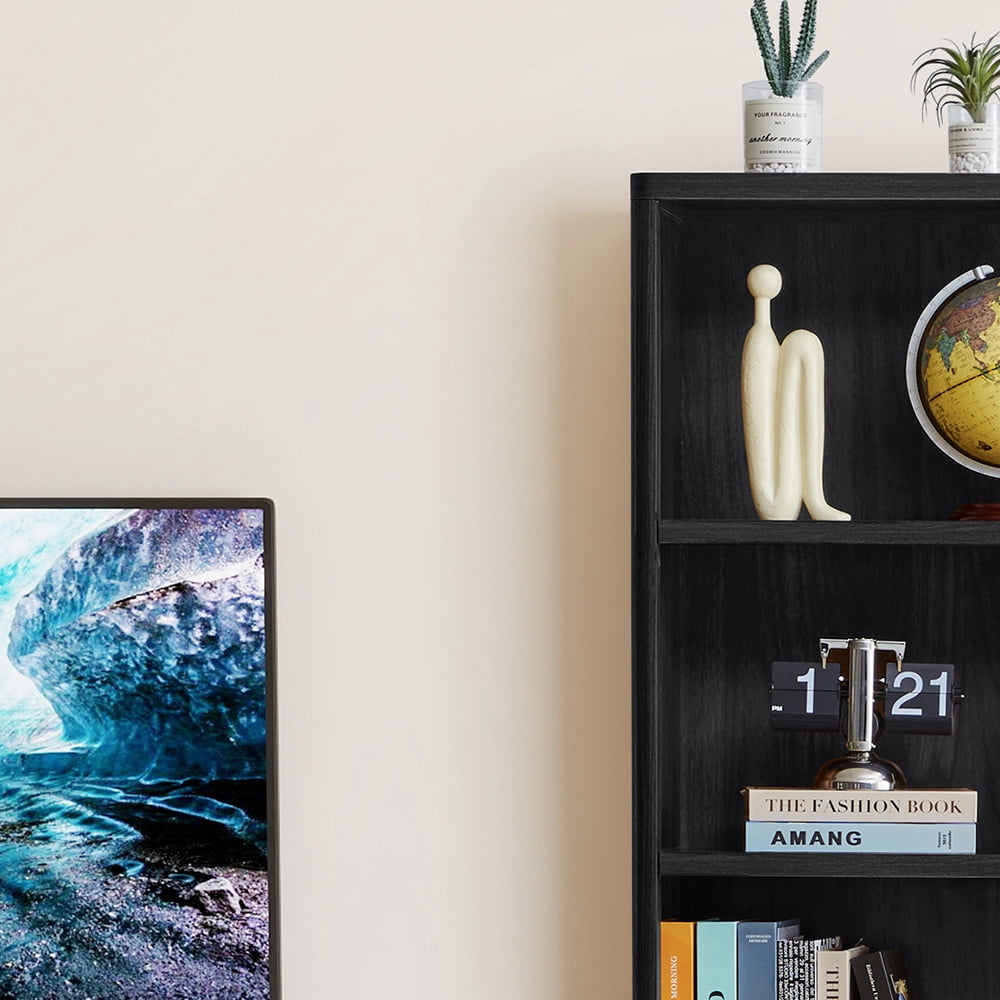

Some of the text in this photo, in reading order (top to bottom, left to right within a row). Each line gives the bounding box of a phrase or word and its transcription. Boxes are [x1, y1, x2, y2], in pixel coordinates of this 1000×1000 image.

[797, 667, 949, 717] 1 21
[765, 798, 962, 814] THE FASHION BOOK
[770, 830, 862, 846] AMANG
[670, 955, 678, 999] MORNING
